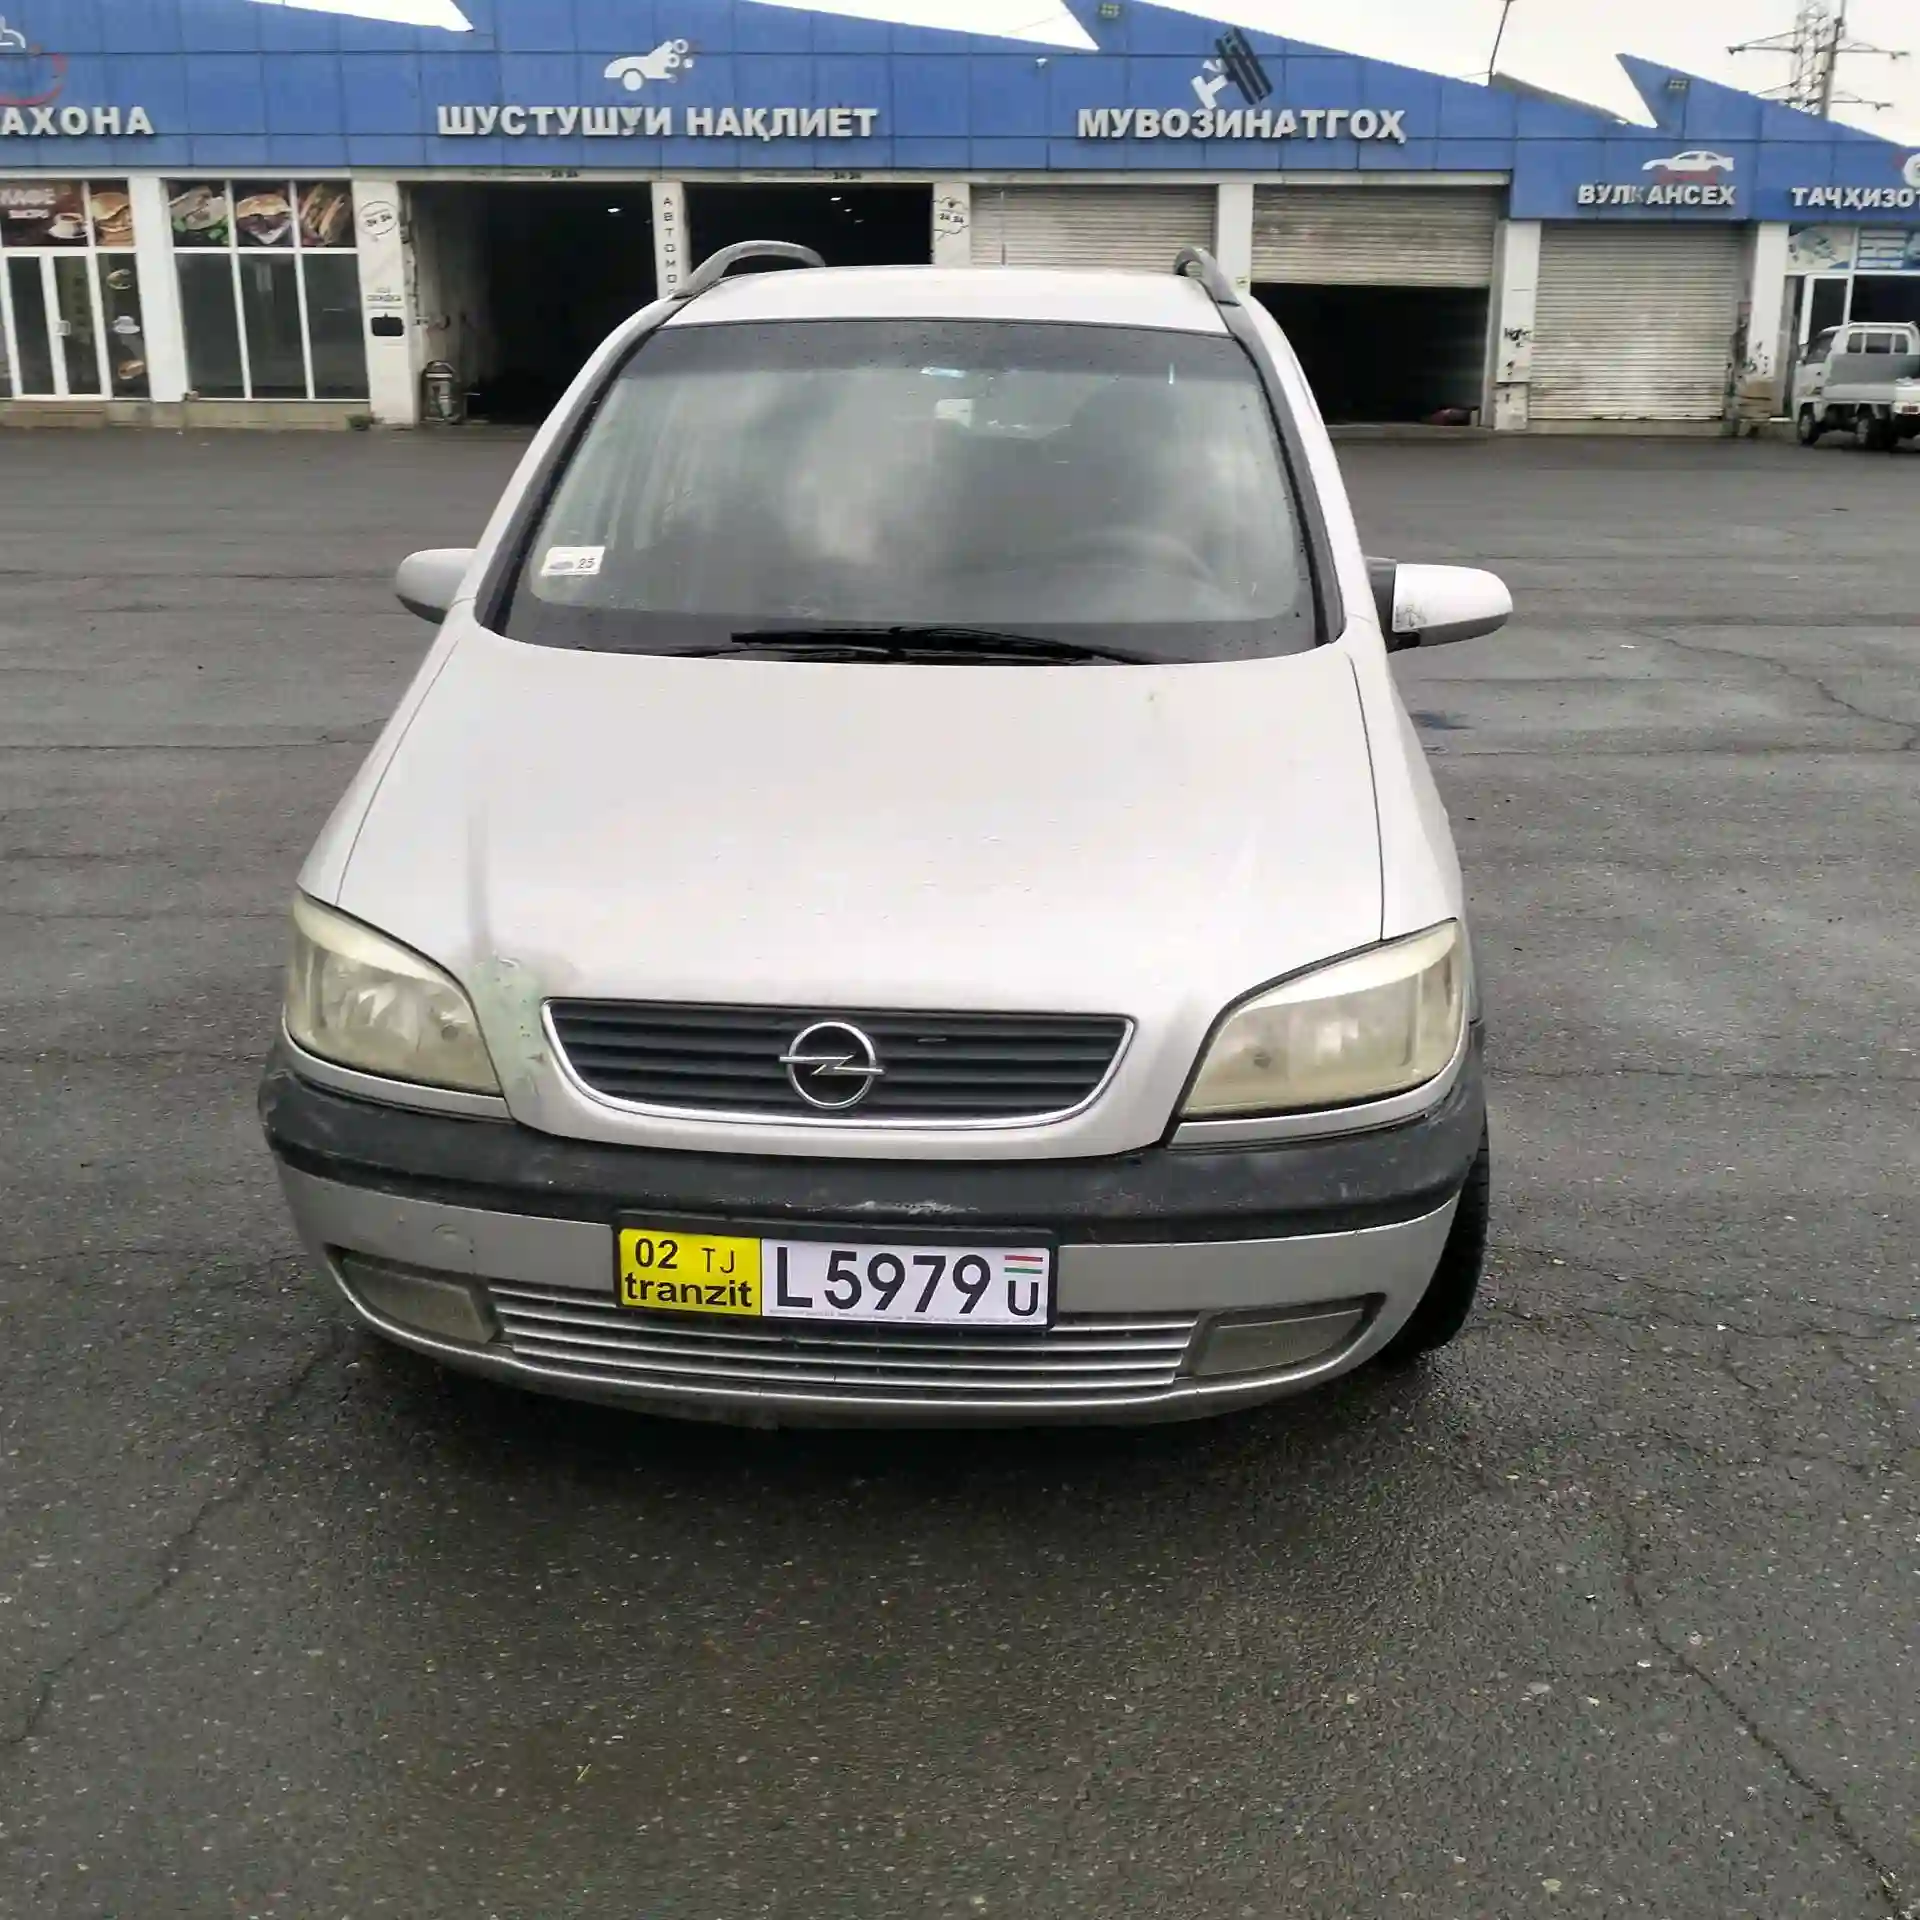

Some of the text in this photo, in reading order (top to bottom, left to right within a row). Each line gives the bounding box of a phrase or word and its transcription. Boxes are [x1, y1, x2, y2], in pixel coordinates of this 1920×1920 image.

[634, 1237, 736, 1275] 02 TJ
[624, 1272, 753, 1309] tranzit
[1006, 1280, 1040, 1318] U
